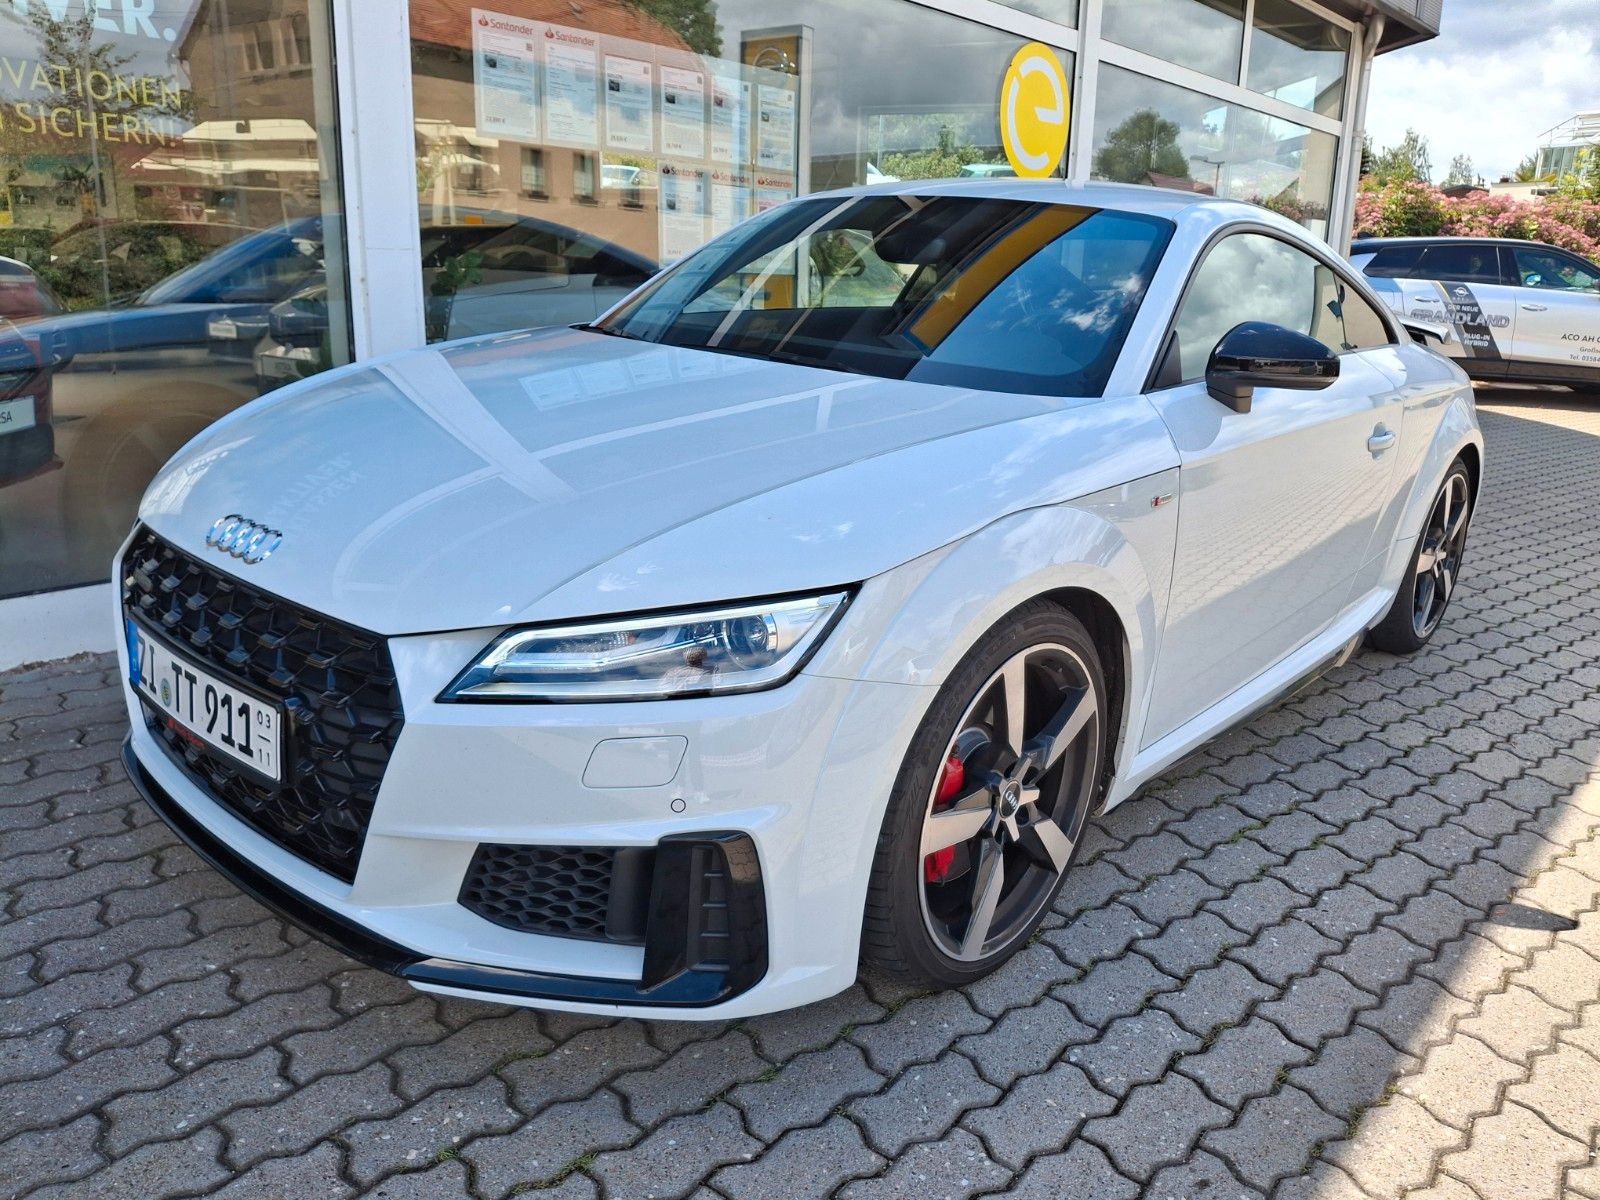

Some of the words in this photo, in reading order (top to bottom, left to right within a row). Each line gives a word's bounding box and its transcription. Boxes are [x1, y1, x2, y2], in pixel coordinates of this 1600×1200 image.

[490, 18, 533, 36] Santander
[555, 31, 595, 47] Santander
[0, 56, 183, 109] VATIONEN
[15, 102, 176, 147] SICHERN!
[670, 166, 704, 178] Santander
[765, 177, 793, 188] Santander
[1462, 305, 1479, 313] NEUE
[1411, 308, 1510, 328] GRANDLAND
[1463, 333, 1491, 341] PLUG-IN
[1561, 333, 1580, 342] ACO
[1581, 335, 1595, 343] AH
[1569, 353, 1580, 361] Tel.
[138, 633, 157, 695] ZI
[171, 660, 197, 723] TT
[204, 684, 254, 758] 911
[257, 710, 271, 729] 03
[258, 748, 270, 767] 11
